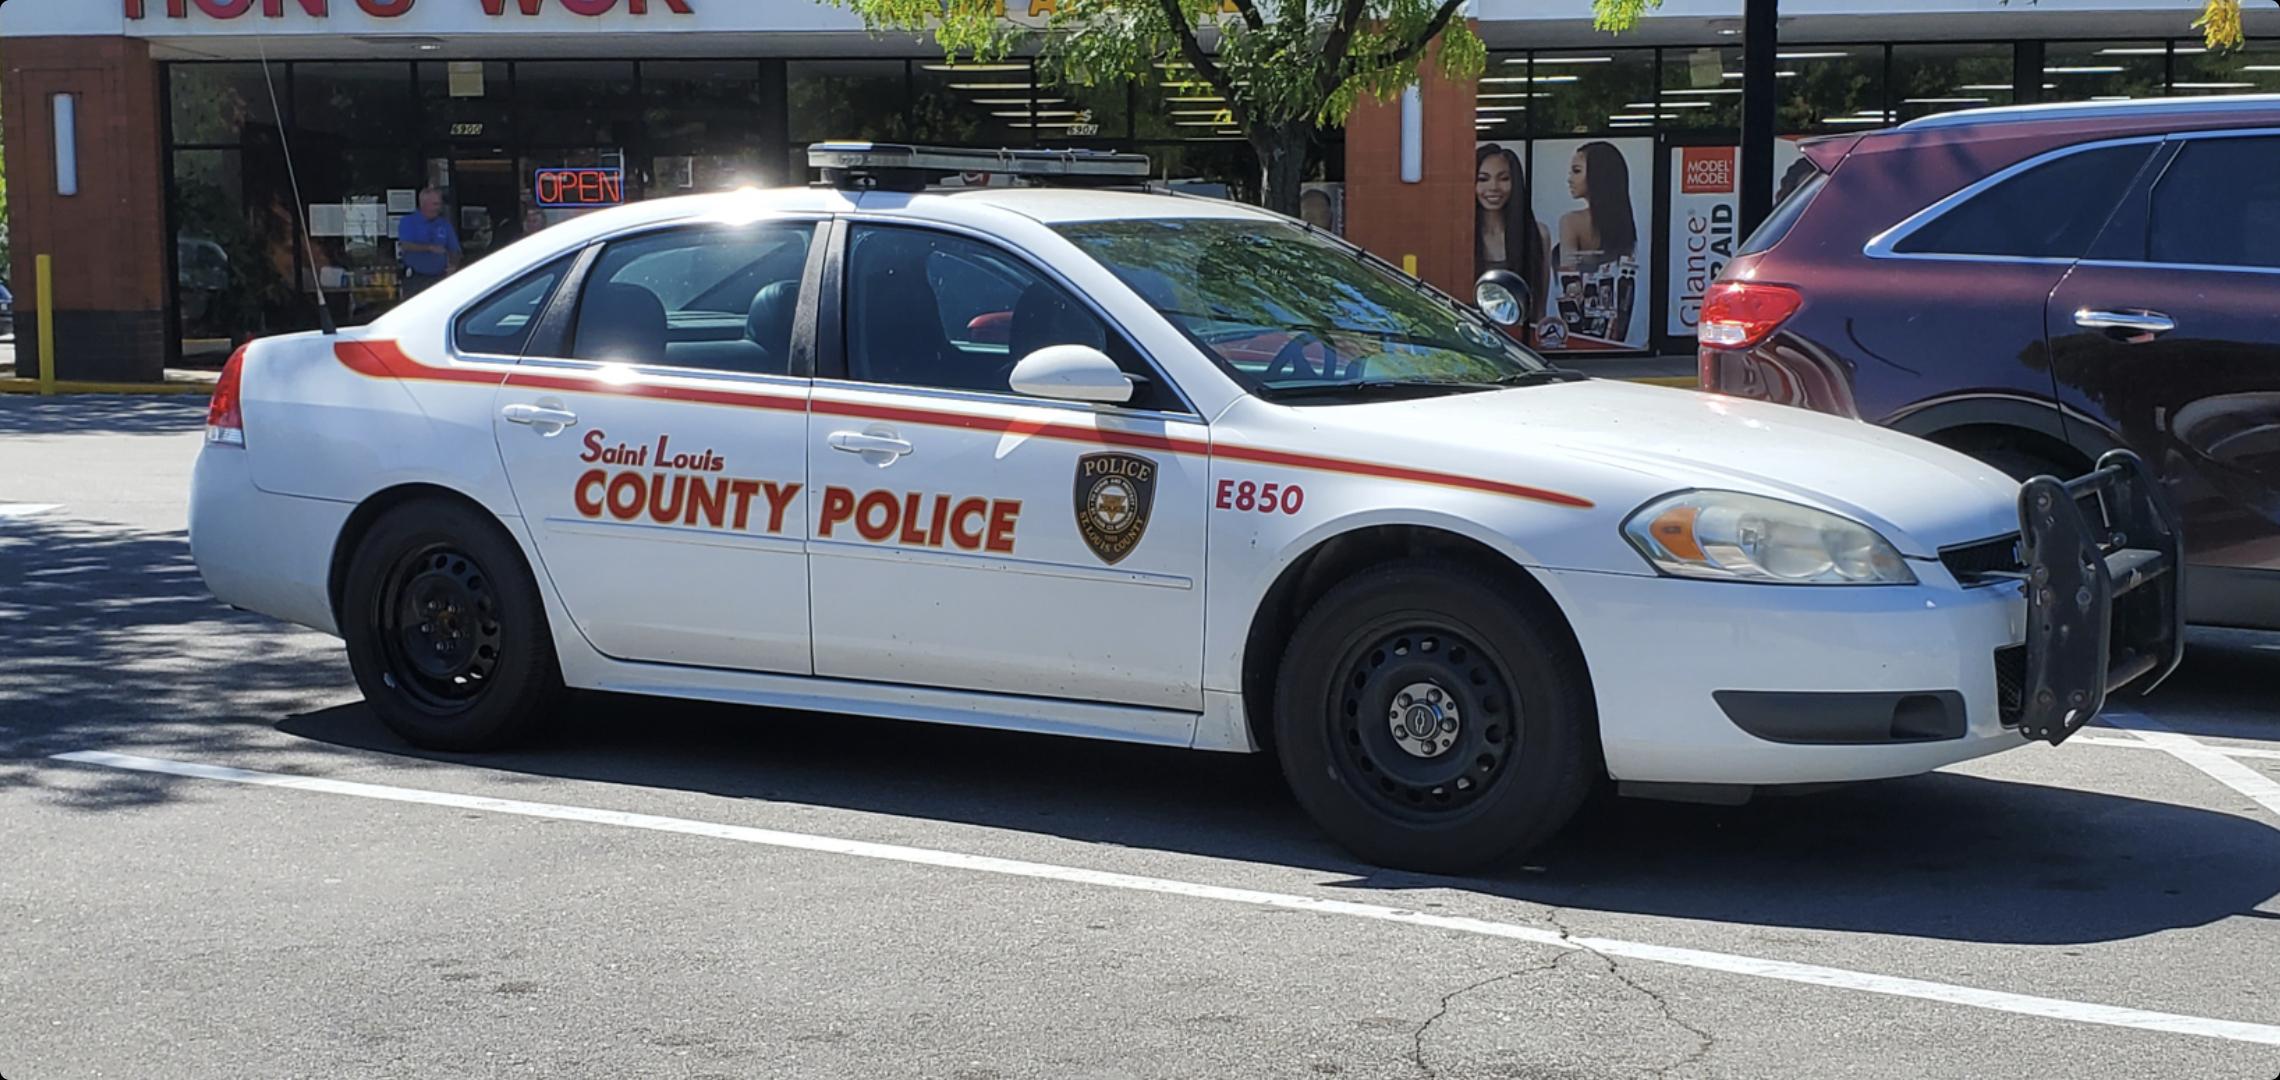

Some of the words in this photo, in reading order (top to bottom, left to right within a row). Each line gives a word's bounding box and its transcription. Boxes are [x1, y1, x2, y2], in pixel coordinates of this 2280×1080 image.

[450, 123, 484, 135] 6900
[1687, 160, 1730, 172] MODEL
[1687, 172, 1730, 184] MODEL
[538, 171, 620, 203] OPEN
[580, 430, 648, 466] Saint
[653, 435, 724, 471] Louis
[1084, 458, 1151, 482] POLICE
[574, 468, 803, 533] COUNTY
[818, 485, 1023, 554] POLICE
[1215, 479, 1304, 515] E850
[1113, 516, 1143, 552] COUNTY
